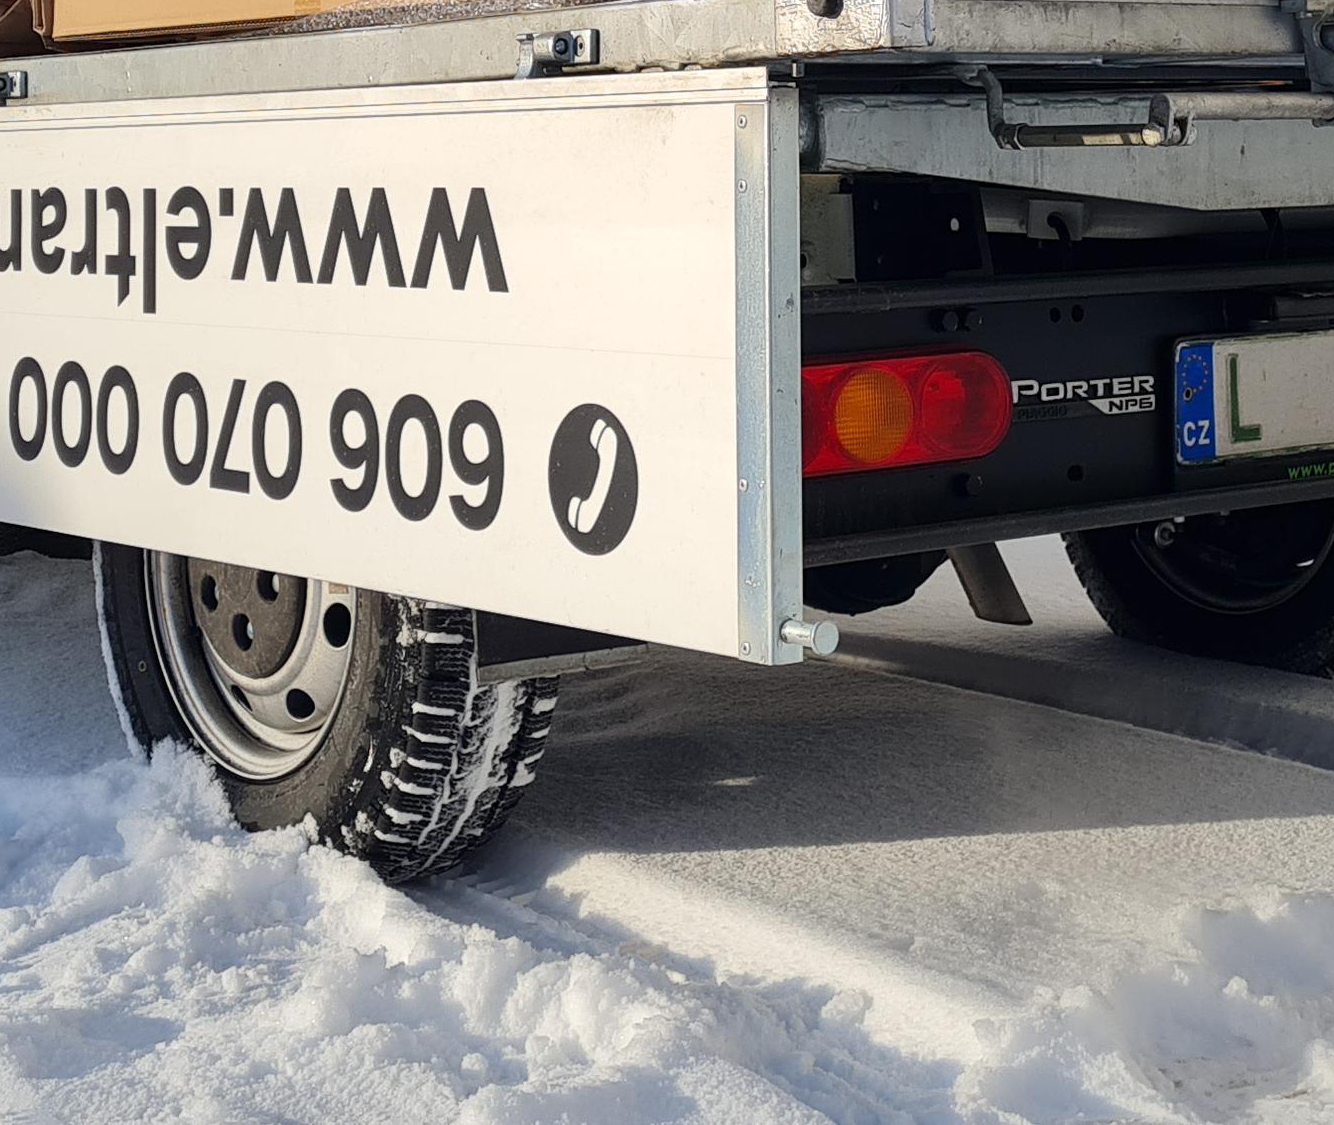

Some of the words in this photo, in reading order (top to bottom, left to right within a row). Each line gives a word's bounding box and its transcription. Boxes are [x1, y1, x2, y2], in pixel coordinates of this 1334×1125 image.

[8, 355, 140, 475] 000
[1010, 375, 1156, 404] PORTER
[1108, 397, 1154, 413] NP6
[1182, 419, 1211, 446] CZ
[1228, 352, 1263, 444] L
[162, 371, 303, 501] 070
[329, 388, 505, 532] 606
